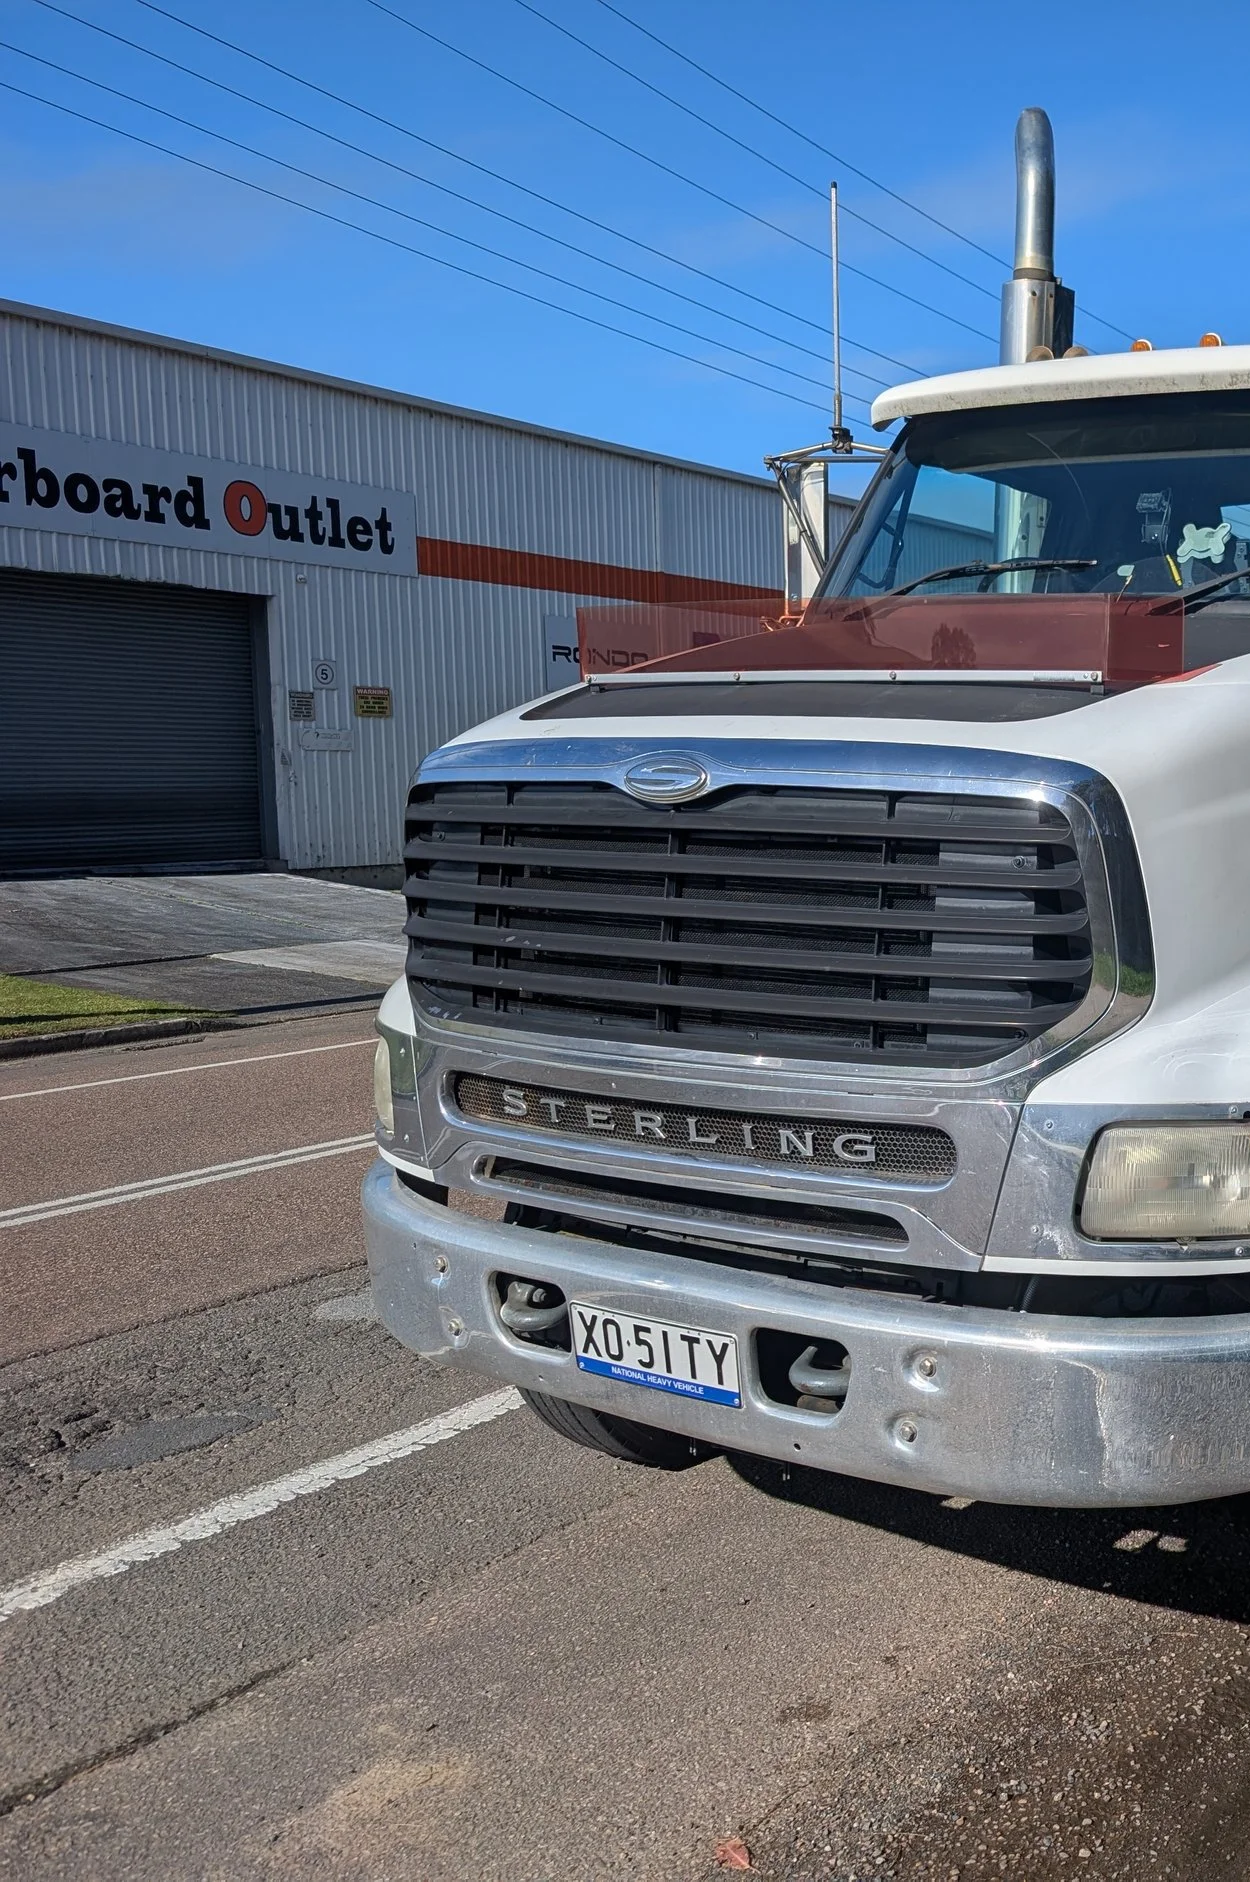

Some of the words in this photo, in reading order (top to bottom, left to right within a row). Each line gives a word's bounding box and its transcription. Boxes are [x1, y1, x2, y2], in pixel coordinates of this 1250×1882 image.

[223, 480, 395, 555] Outlet
[320, 669, 328, 680] 5
[502, 1088, 877, 1164] STERLING
[611, 1365, 647, 1382] NATIONAL
[647, 1376, 672, 1387] HEAVY
[672, 1381, 705, 1395] VEHICLE
